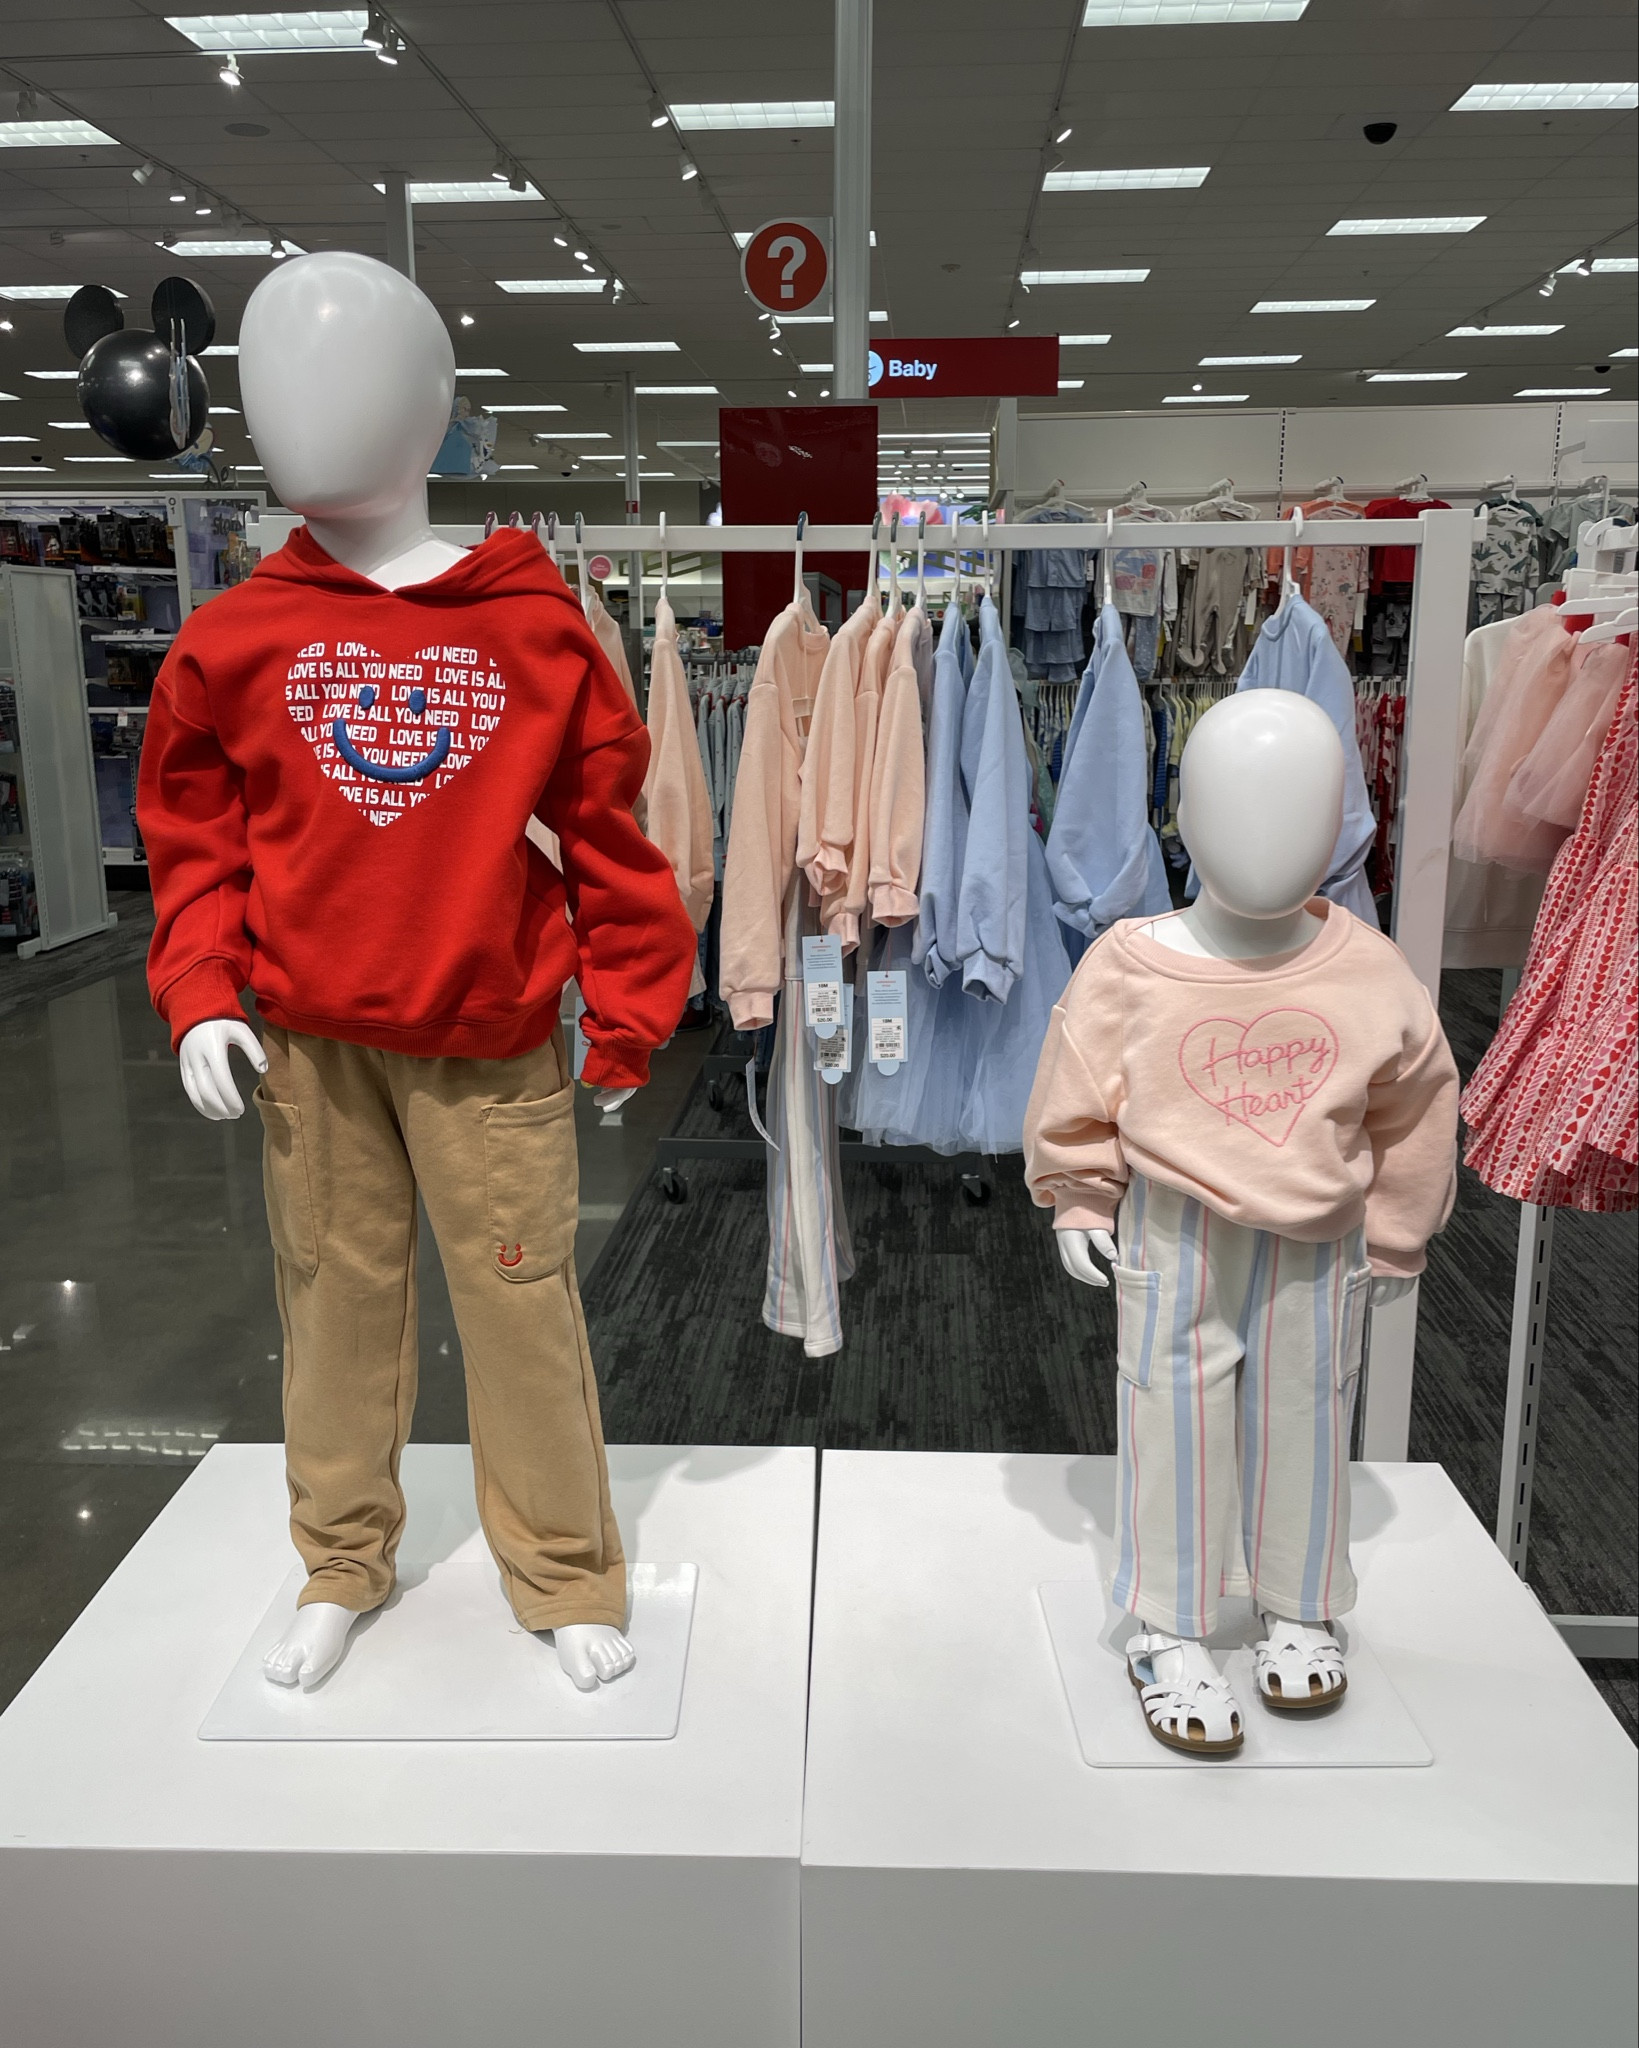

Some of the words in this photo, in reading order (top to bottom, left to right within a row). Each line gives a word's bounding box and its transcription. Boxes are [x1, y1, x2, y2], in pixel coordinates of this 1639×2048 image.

[888, 359, 938, 381] Baby
[442, 646, 478, 666] NEED
[287, 662, 317, 680] LOVE
[320, 662, 334, 678] IS
[336, 662, 360, 679] ALL
[361, 662, 386, 679] YOU
[388, 664, 423, 681] NEED
[434, 667, 469, 686] LOVE
[471, 670, 485, 688] IS
[295, 683, 320, 700] ALL
[321, 683, 347, 699] YOU
[427, 687, 440, 704] IS
[442, 689, 468, 707] ALL
[471, 691, 498, 711] YOU
[322, 703, 353, 719] LOVE
[367, 705, 392, 723] ALL
[424, 709, 460, 728] NEED
[389, 728, 424, 747] LOVE
[449, 731, 466, 749] LL
[322, 742, 335, 759] IS
[361, 746, 390, 765] YOU
[331, 763, 357, 781] ALL
[365, 787, 380, 805] IS
[380, 789, 406, 807] ALL
[1202, 1036, 1331, 1087] Happy
[1217, 1075, 1313, 1127] Heart
